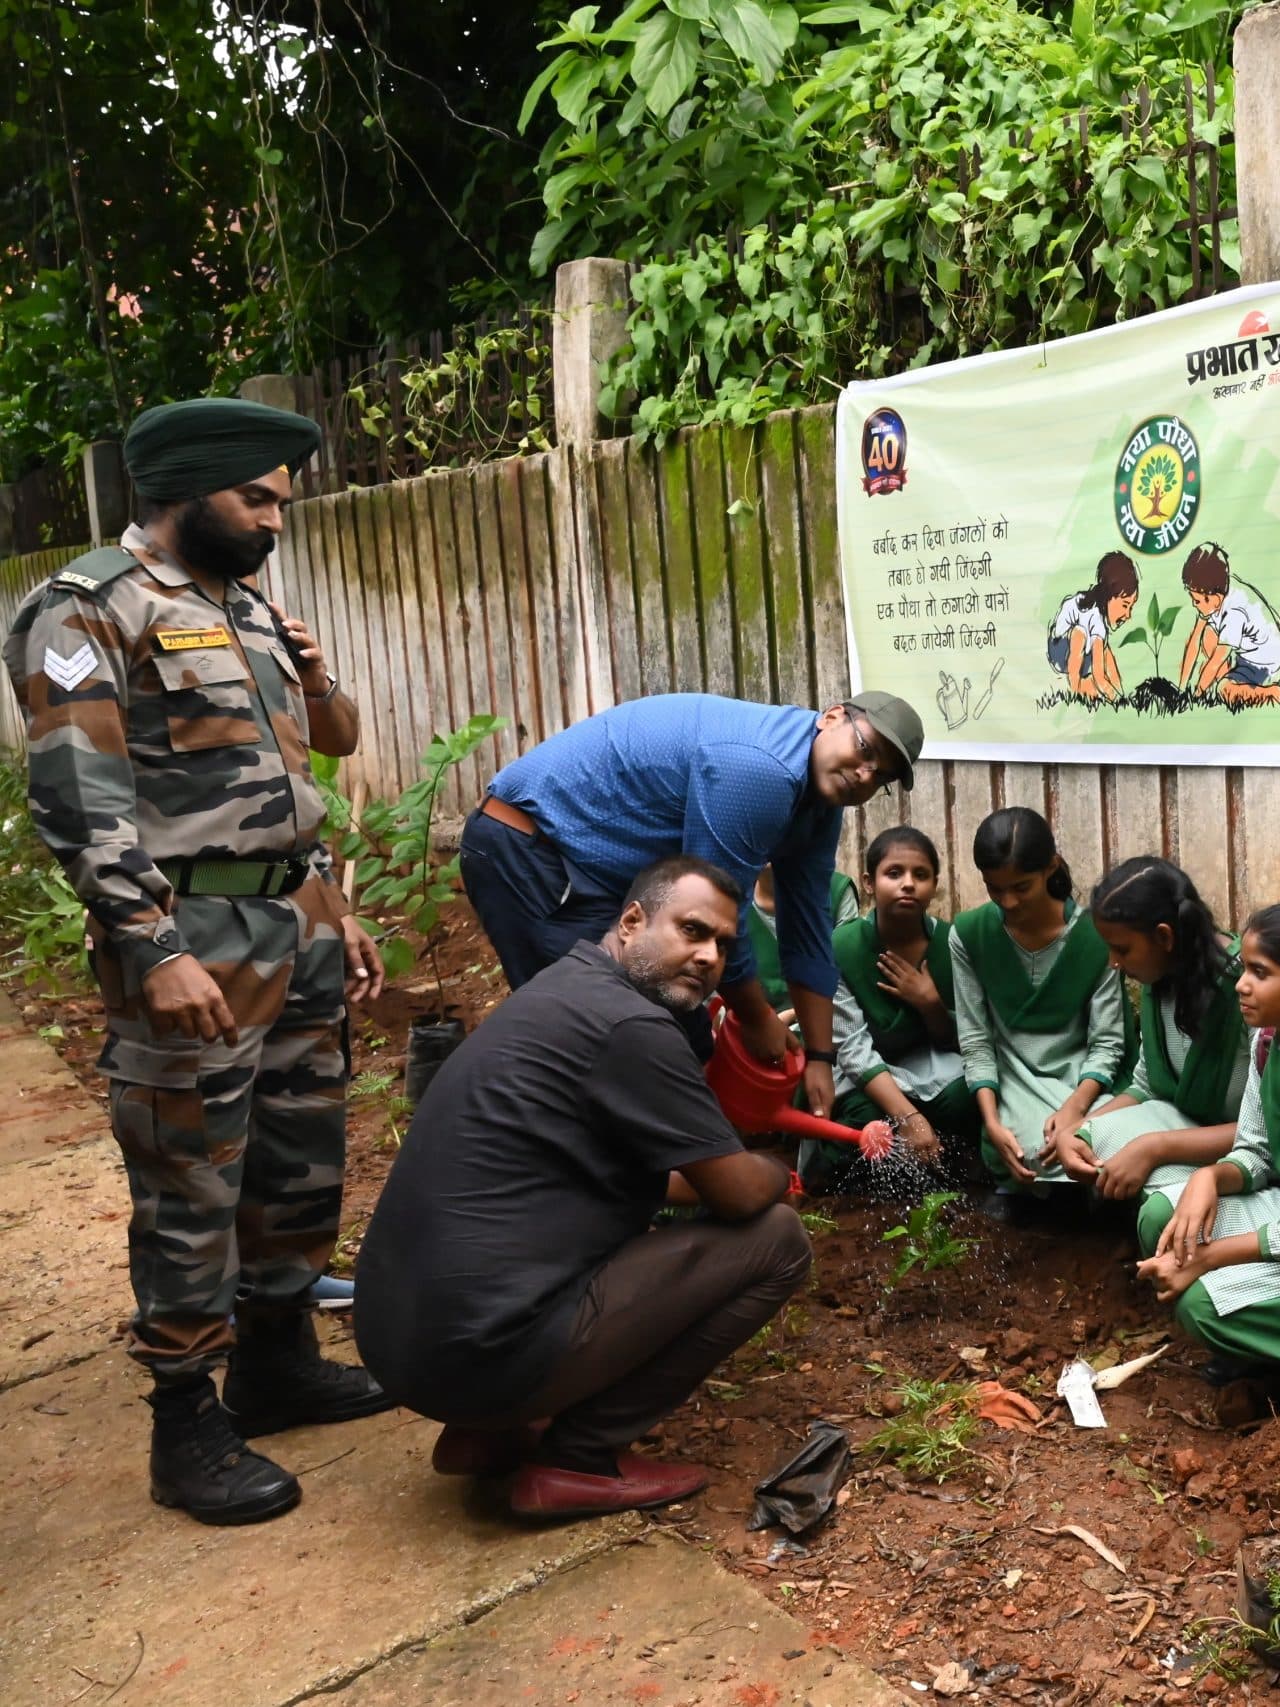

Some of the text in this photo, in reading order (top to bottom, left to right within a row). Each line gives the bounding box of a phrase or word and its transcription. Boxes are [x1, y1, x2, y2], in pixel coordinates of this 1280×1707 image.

[1186, 339, 1259, 386] प्रभात
[868, 433, 899, 472] 40
[1120, 416, 1197, 472] नया पौधा
[872, 529, 897, 555] बर्बाद
[922, 525, 945, 551] दिया
[949, 516, 987, 545] जंगलों
[992, 513, 1009, 540] को
[1121, 492, 1196, 549] नया जीवन
[888, 551, 993, 587] तबाह हो गयी जिंदगी
[877, 584, 1009, 620] एक पौधा तो लगाओ यारों
[893, 621, 997, 653] बदल जायेगी जिंदगी
